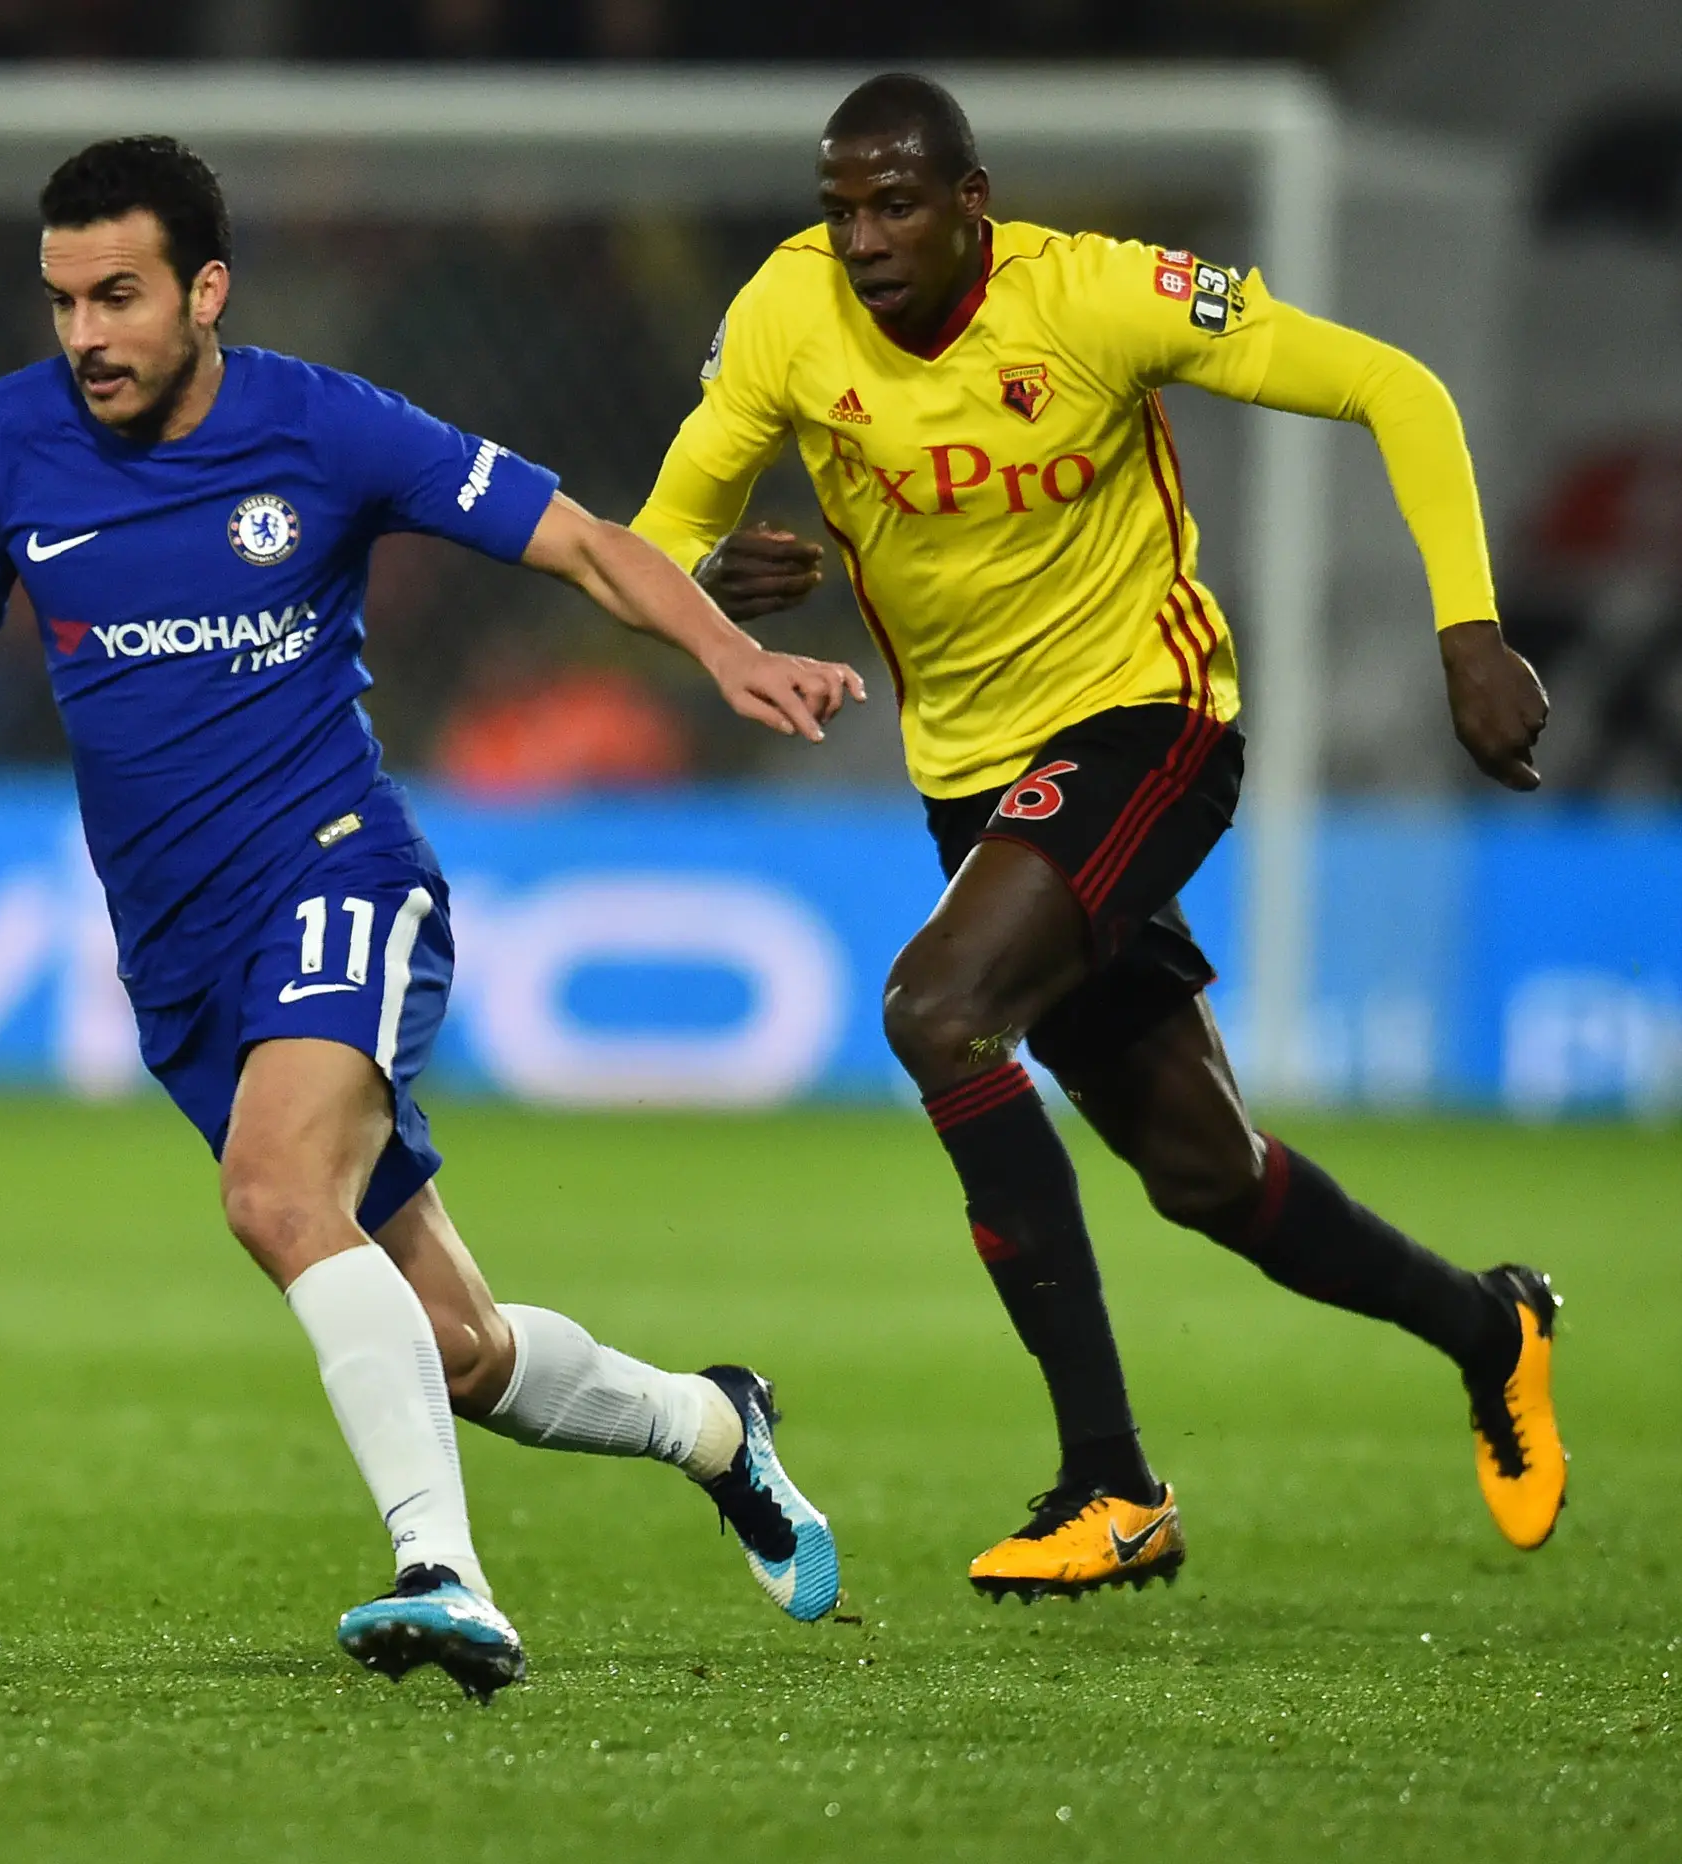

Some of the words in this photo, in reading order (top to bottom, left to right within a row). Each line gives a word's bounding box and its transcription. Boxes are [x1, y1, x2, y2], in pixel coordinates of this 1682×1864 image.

[828, 408, 872, 425] adidas
[830, 431, 1096, 516] FxPro
[91, 601, 317, 658] YOKOHAMA
[230, 626, 317, 674] TYRES
[296, 896, 375, 986] 11
